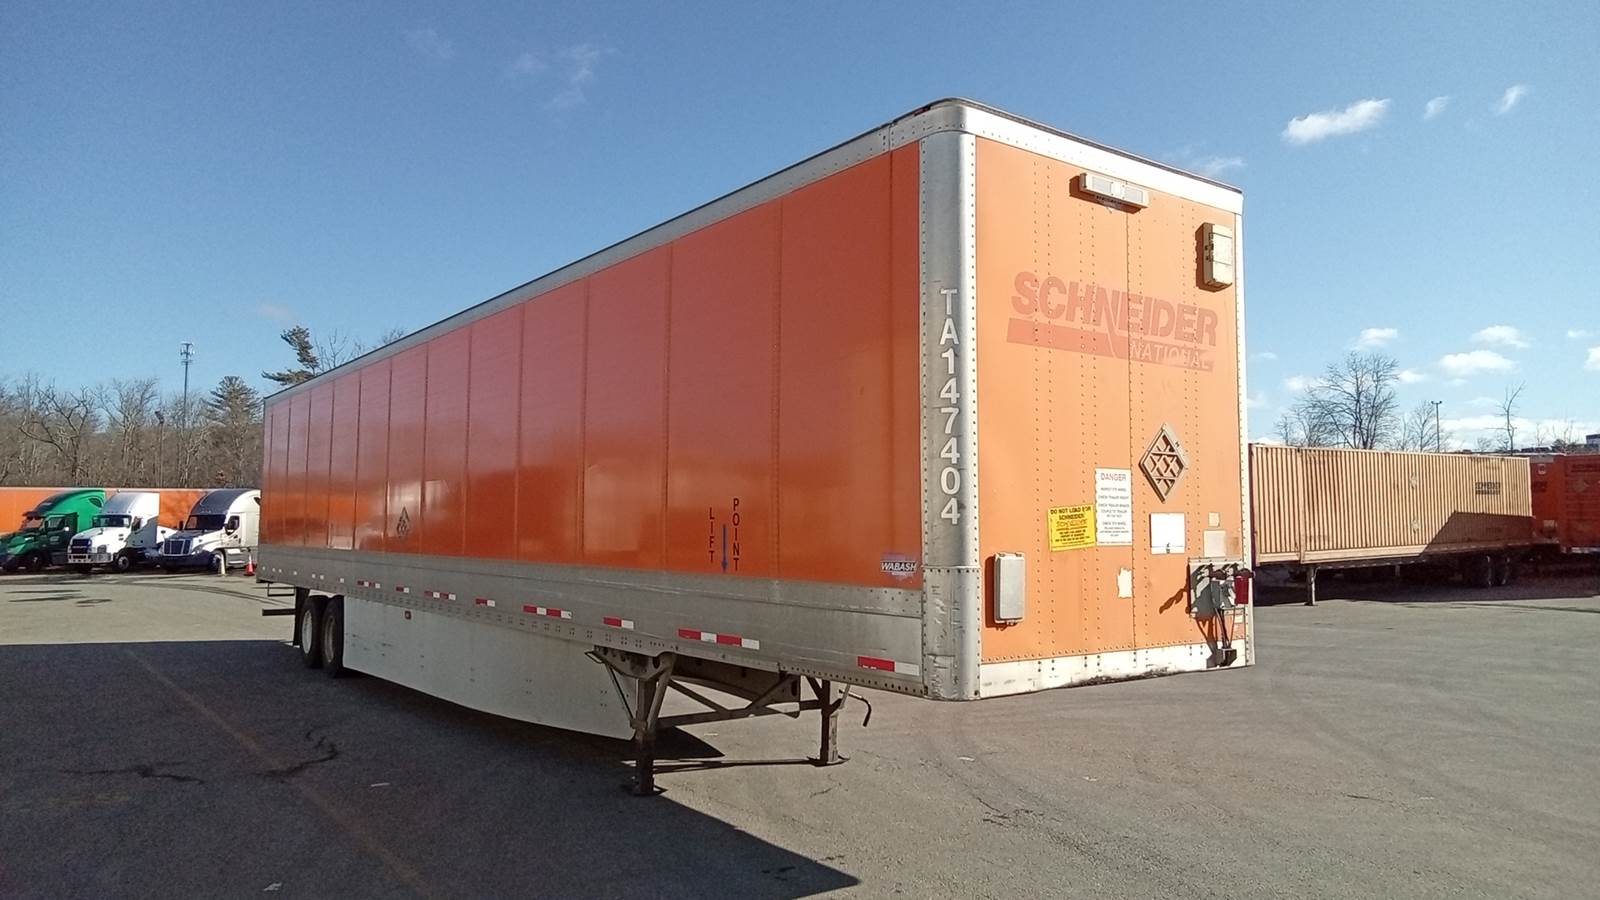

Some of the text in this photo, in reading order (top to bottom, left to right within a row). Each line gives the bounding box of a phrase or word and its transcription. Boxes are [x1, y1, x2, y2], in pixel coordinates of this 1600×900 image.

[1011, 271, 1218, 347] SCHNEIDER
[1130, 341, 1210, 370] NATIONAL
[939, 288, 961, 525] TA147404
[1101, 473, 1126, 481] DANGER
[732, 497, 740, 571] POINT
[880, 561, 918, 572] WABASH
